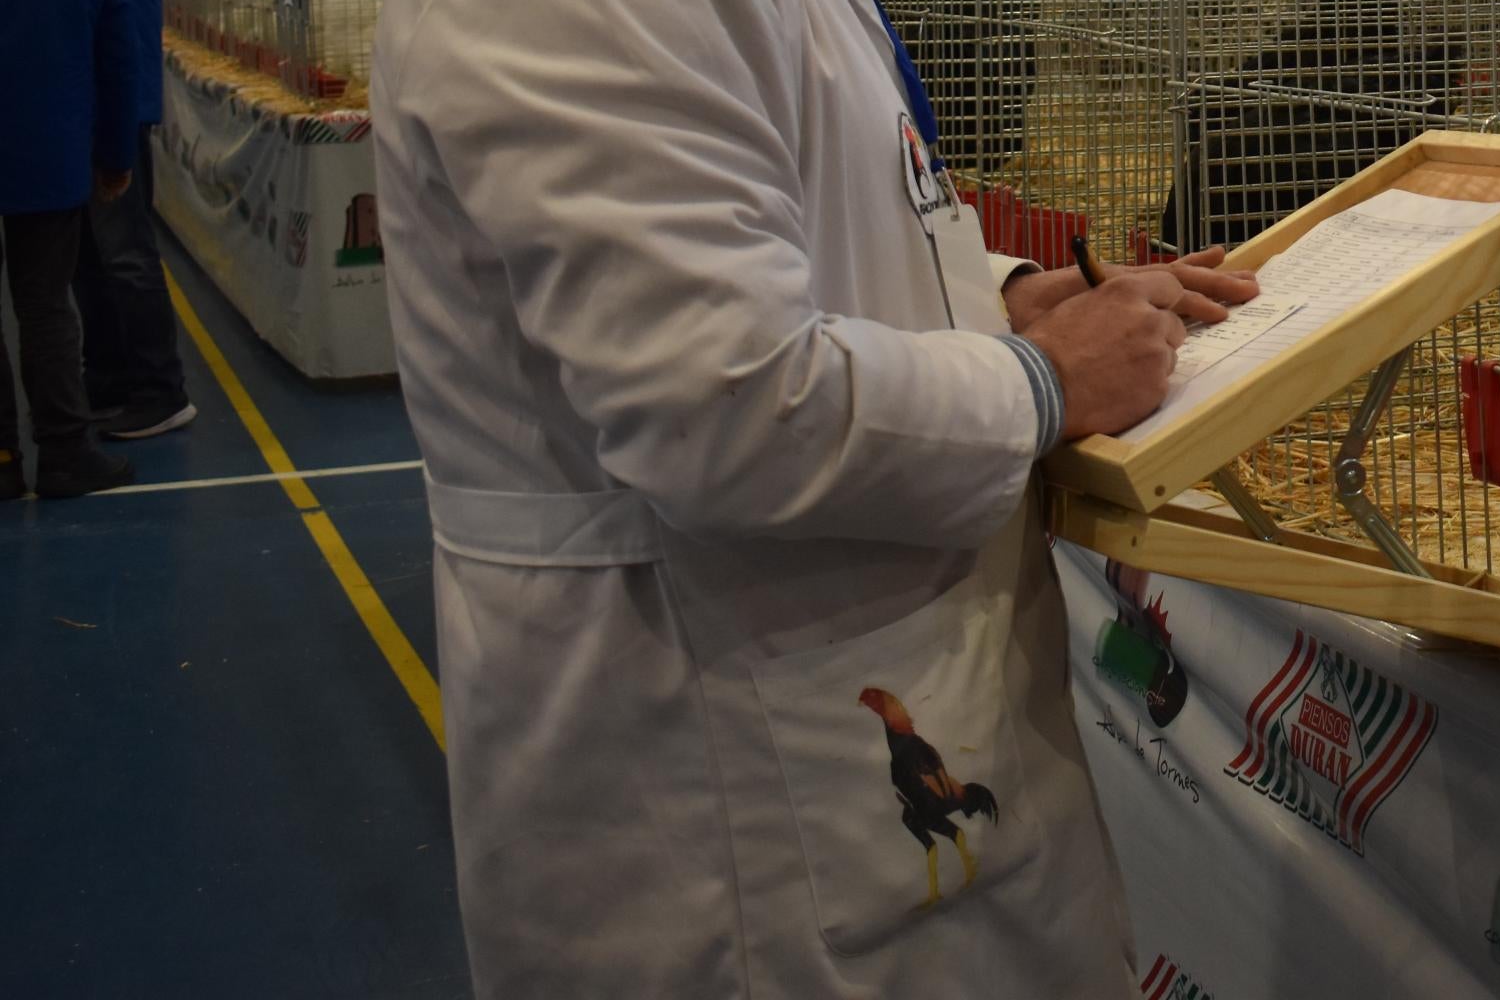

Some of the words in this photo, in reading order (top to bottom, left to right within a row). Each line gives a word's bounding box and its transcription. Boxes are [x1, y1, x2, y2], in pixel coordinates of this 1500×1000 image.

[1302, 698, 1350, 744] PIENSOS
[1149, 737, 1200, 804] Tormes
[1291, 723, 1353, 791] DURAN
